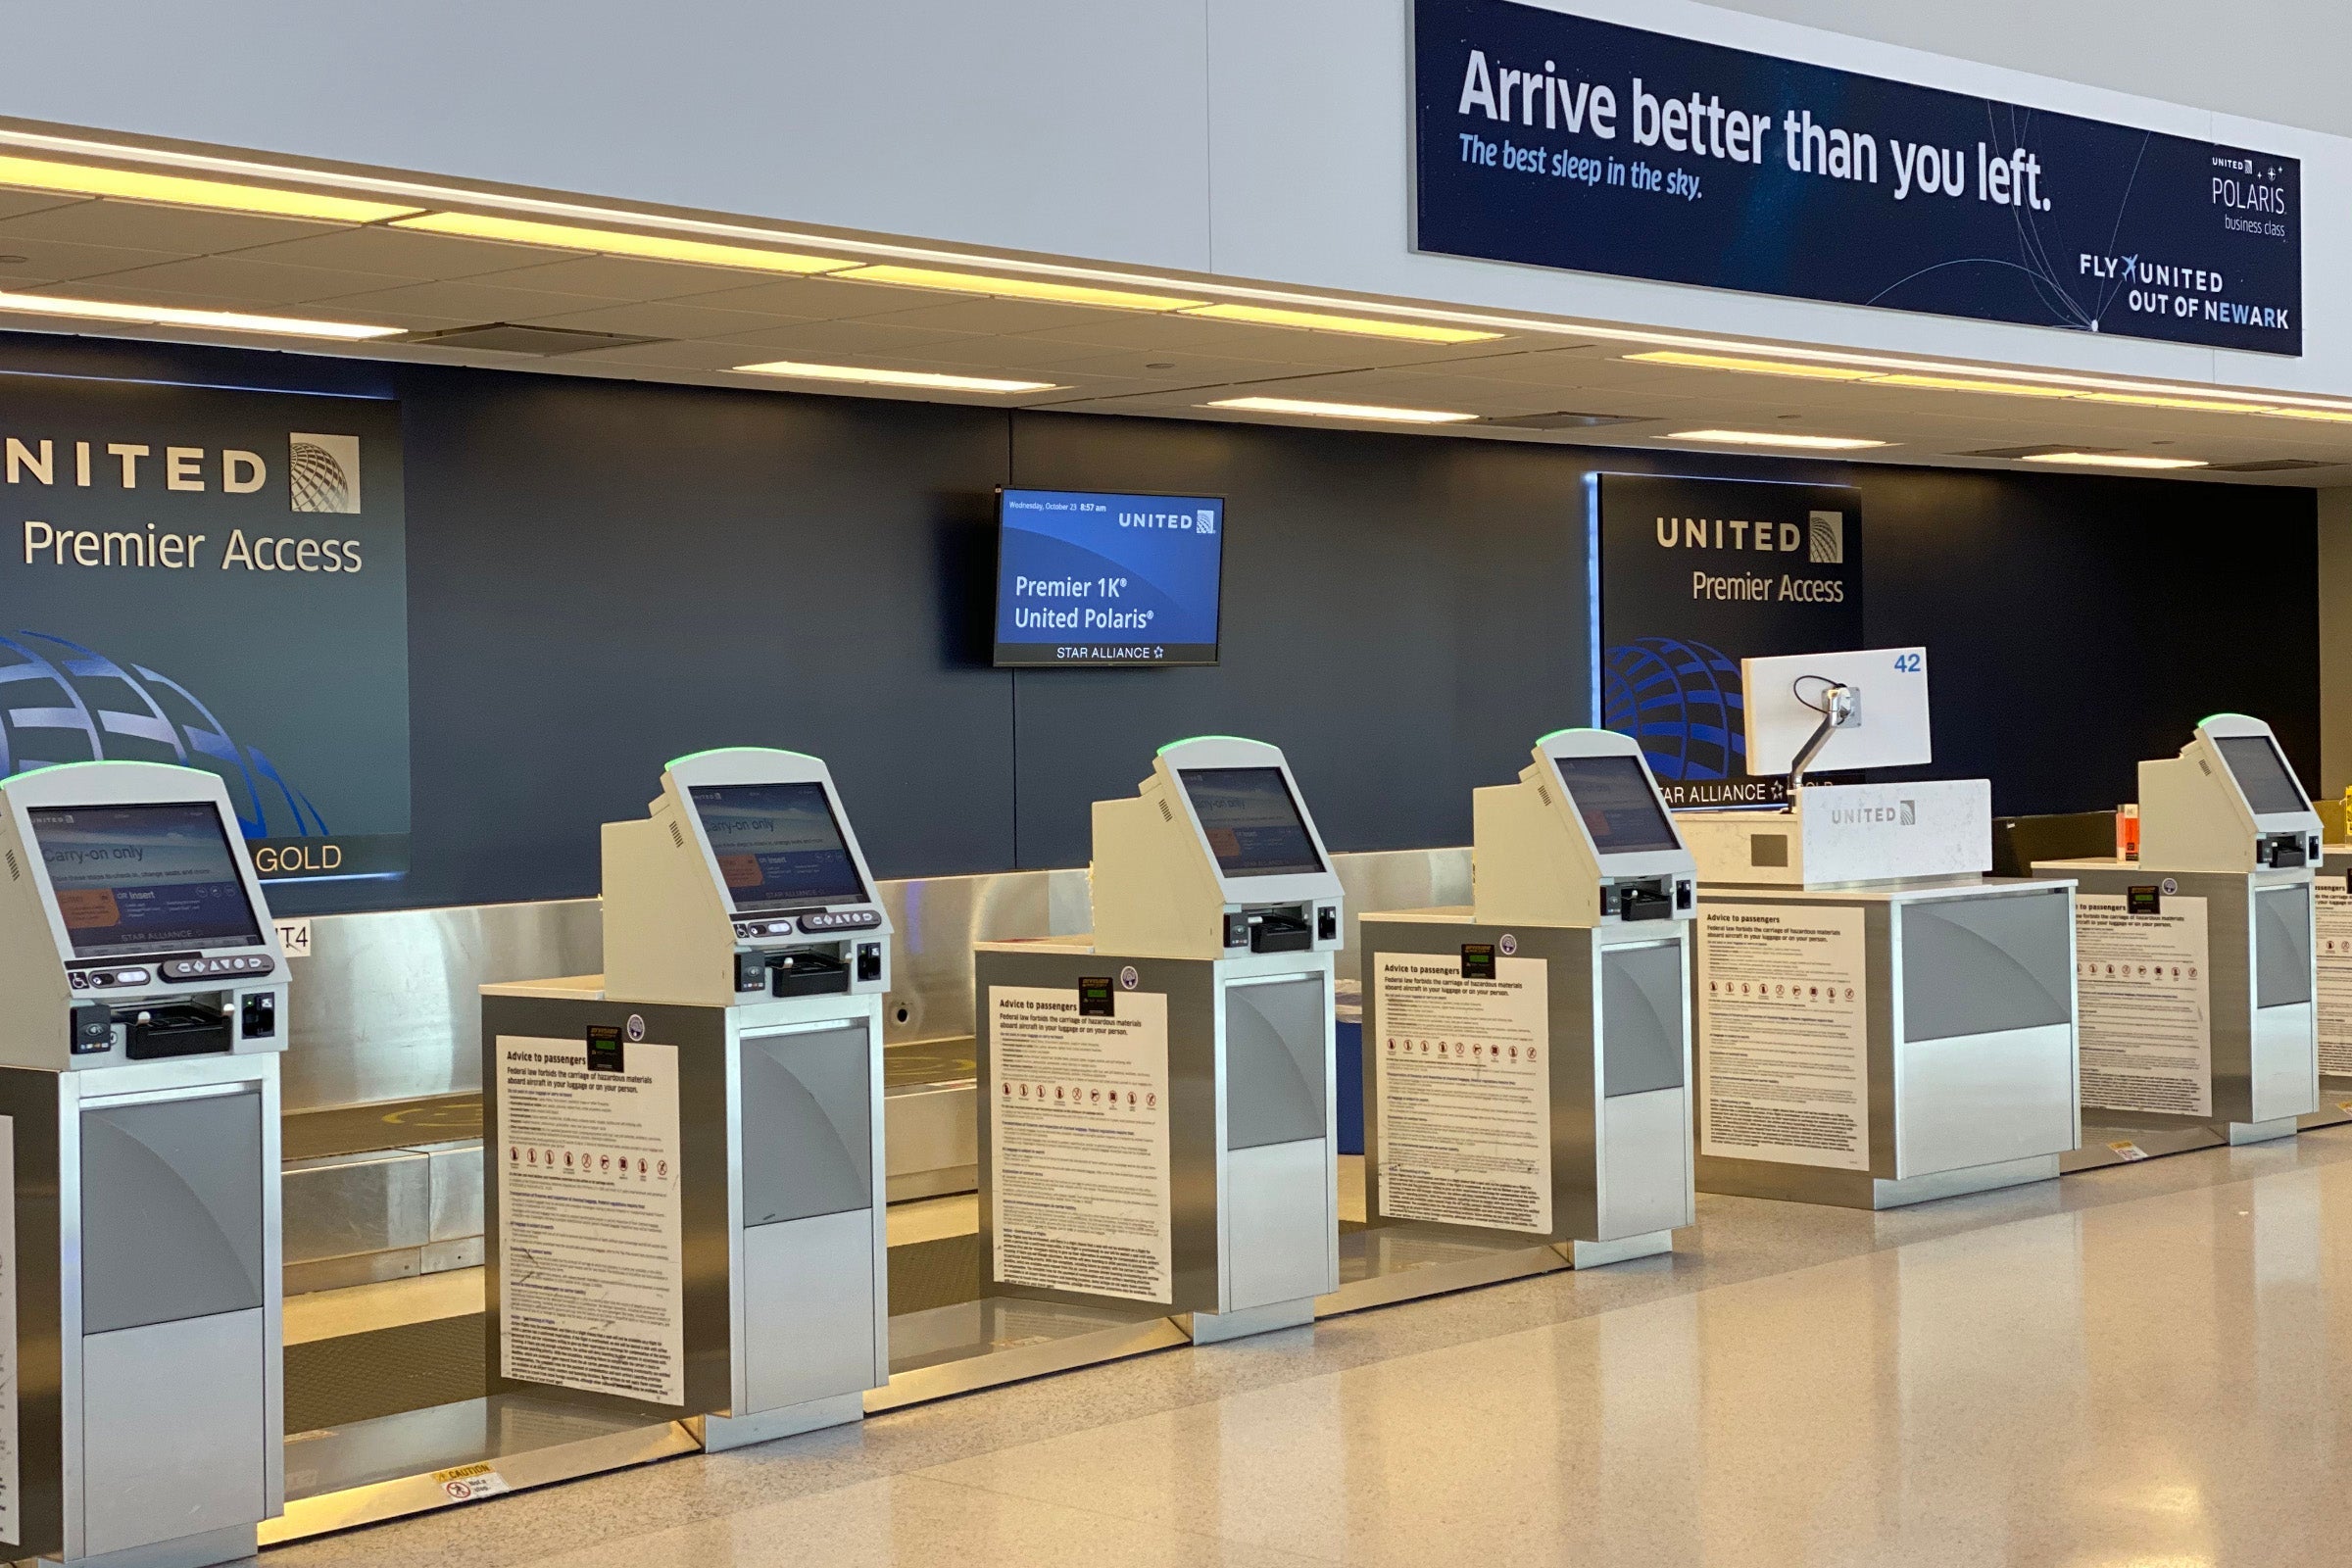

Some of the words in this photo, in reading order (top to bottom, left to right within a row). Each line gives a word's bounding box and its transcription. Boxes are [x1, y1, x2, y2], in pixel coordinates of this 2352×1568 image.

[1458, 49, 1616, 139] Arrive
[1633, 77, 1771, 165] better
[1784, 110, 1878, 183] than
[1889, 139, 1965, 200] you
[1978, 142, 2051, 212] left.
[1459, 133, 1496, 167] The
[1502, 139, 1546, 174] best
[1551, 149, 1601, 187] sleep
[1607, 156, 1625, 186] in
[1631, 162, 1661, 192] the
[1666, 169, 1702, 202] sky.
[2212, 157, 2243, 171] UNITED
[2212, 177, 2285, 215] POLARIS
[2225, 214, 2263, 235] business
[2264, 220, 2285, 237] class
[2080, 254, 2119, 279] FLY
[2139, 263, 2223, 293] UNITED
[2129, 290, 2169, 315] OUT
[2174, 296, 2199, 318] OF
[2205, 301, 2289, 330] NEWARK
[6, 438, 267, 493] NITED
[1009, 502, 1044, 511] Wednesday,
[1118, 513, 1192, 529] UNITED
[1656, 517, 1800, 553] UNITED
[24, 520, 205, 568] Premier
[220, 529, 363, 573] Access
[1016, 576, 1092, 597] Premier
[1692, 570, 1773, 601] Premier
[1778, 574, 1843, 603] Access
[1015, 608, 1078, 628] United
[1056, 648, 1088, 659] STAR
[1091, 648, 1151, 659] ALLIANCE
[1894, 654, 1921, 673] 42
[1658, 787, 1685, 803] AR
[1690, 784, 1766, 803] ALLIANCE
[1832, 808, 1895, 824] UNITED
[753, 820, 774, 832] only
[42, 849, 108, 864] Carry-on
[113, 845, 143, 861] only
[256, 846, 342, 871] GOLD
[129, 891, 156, 900] Insert
[148, 930, 193, 941] ALLIANCE
[275, 927, 309, 949] T4
[1384, 964, 1409, 973] Advice
[1420, 967, 1460, 976] passengers
[1000, 999, 1024, 1008] Advice
[1036, 1002, 1077, 1012] passengers
[507, 1051, 532, 1061] Advice
[534, 1053, 542, 1062] to
[544, 1054, 586, 1066] passengers
[566, 1081, 588, 1090] luggage
[567, 1071, 589, 1080] carriage
[598, 1073, 625, 1082] hazardous
[448, 1465, 490, 1479] CAUTION
